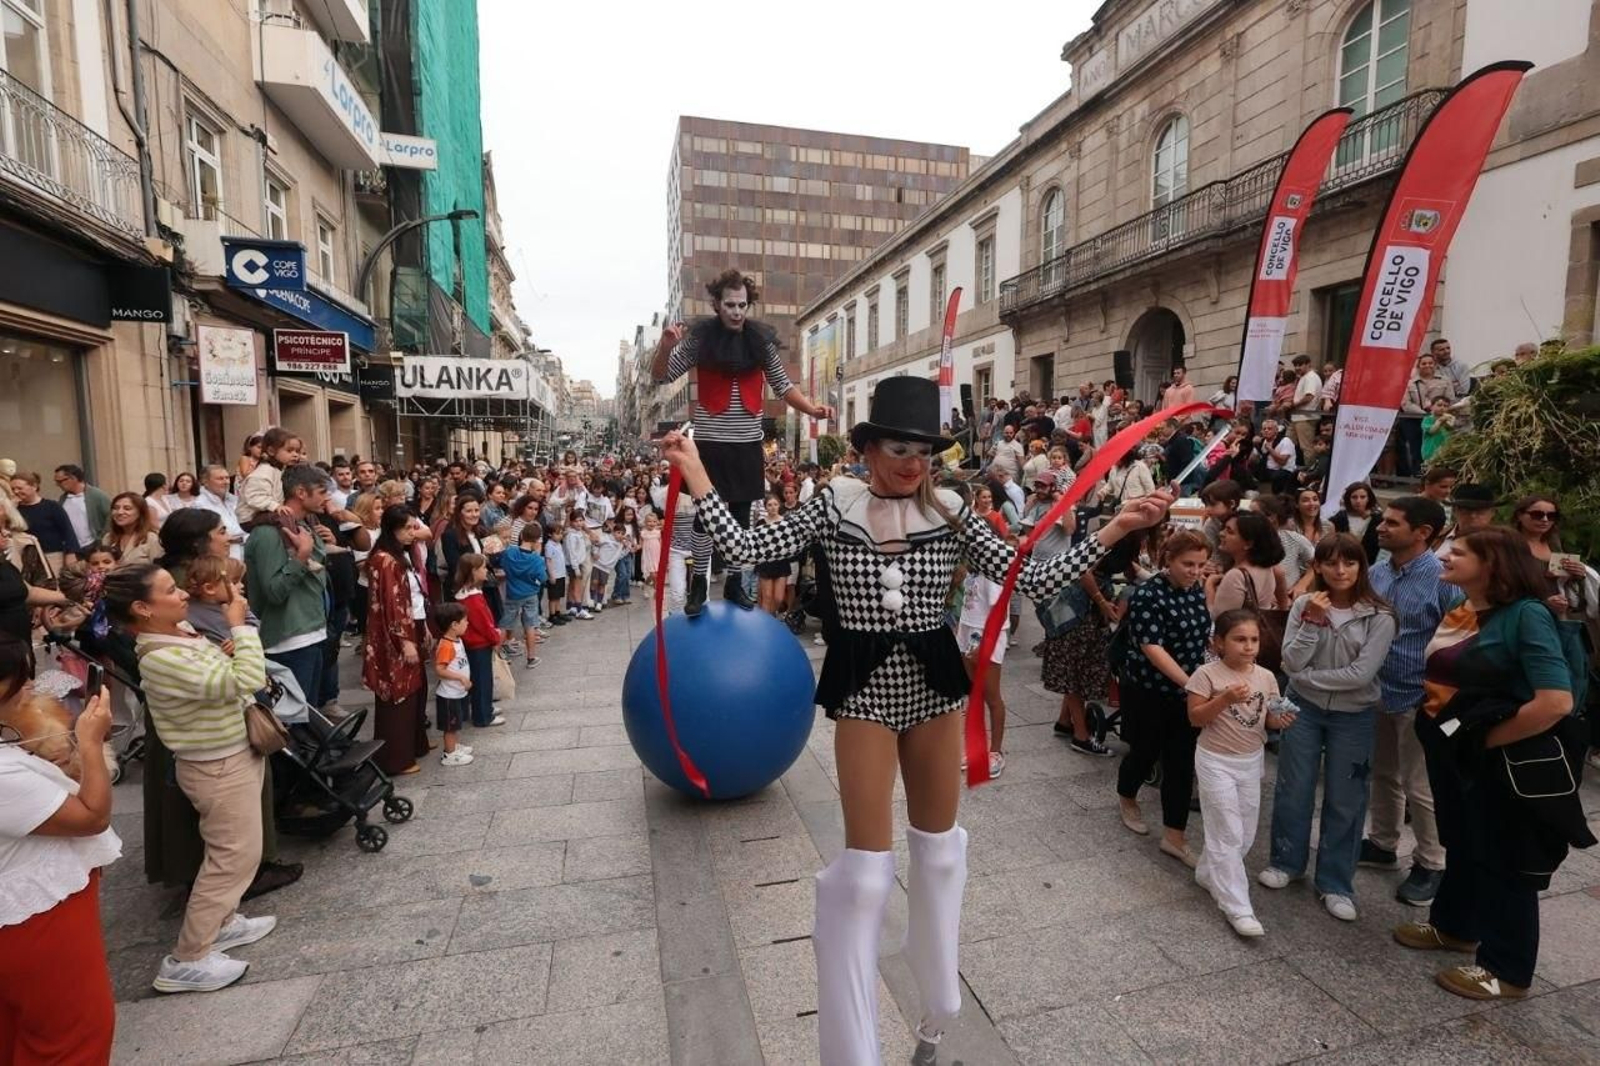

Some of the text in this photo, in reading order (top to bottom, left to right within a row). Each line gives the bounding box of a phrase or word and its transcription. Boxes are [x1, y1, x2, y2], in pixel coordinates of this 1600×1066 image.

[331, 60, 374, 145] Larpro
[385, 140, 435, 158] Larpro
[1265, 221, 1286, 276] CONCELLO
[272, 259, 298, 271] COPE
[1275, 256, 1285, 270] DE
[273, 269, 299, 279] VIGO
[1370, 254, 1405, 341] CONCELLO
[1386, 266, 1420, 332] DE VIGO
[111, 308, 164, 319] MANGO
[278, 335, 343, 347] PSICOTÉCNICO
[360, 379, 391, 387] MANGO
